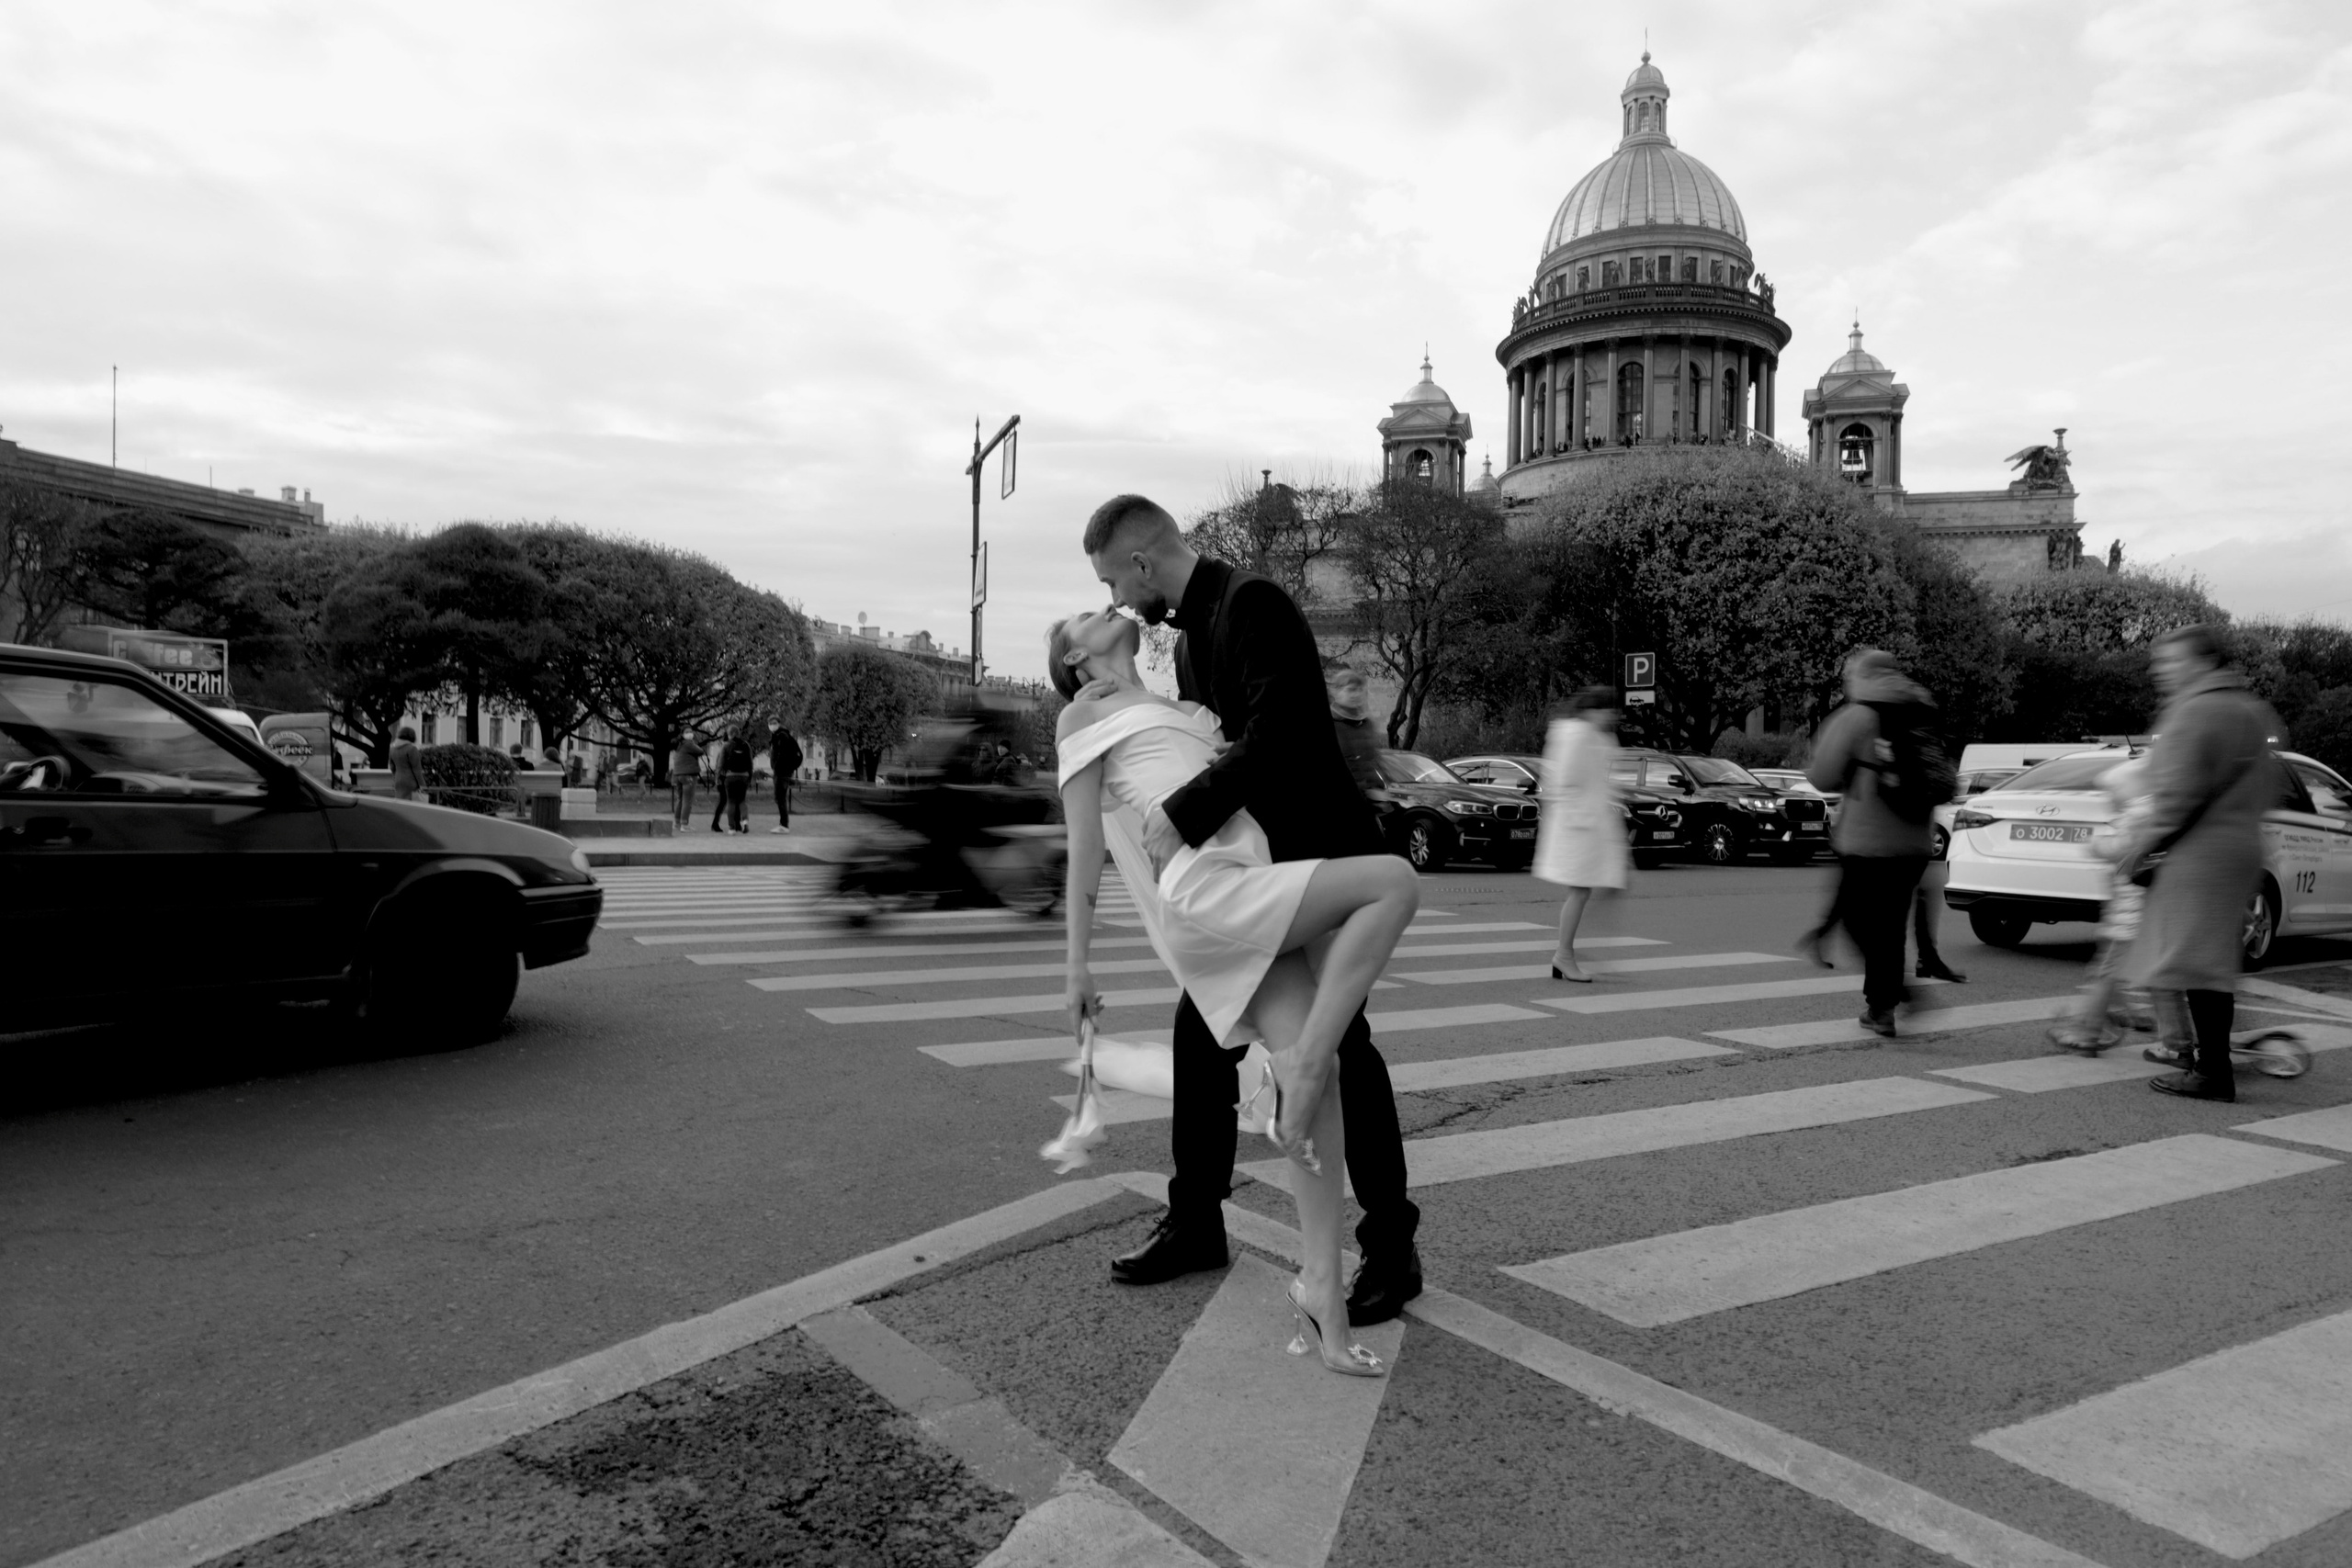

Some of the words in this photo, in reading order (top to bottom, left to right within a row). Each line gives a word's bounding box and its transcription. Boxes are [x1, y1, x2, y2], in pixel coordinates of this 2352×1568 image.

[115, 640, 193, 666] Cfee
[1634, 657, 1649, 682] P
[2030, 827, 2064, 841] 3002
[2074, 826, 2087, 838] 78
[2296, 870, 2316, 894] 112
